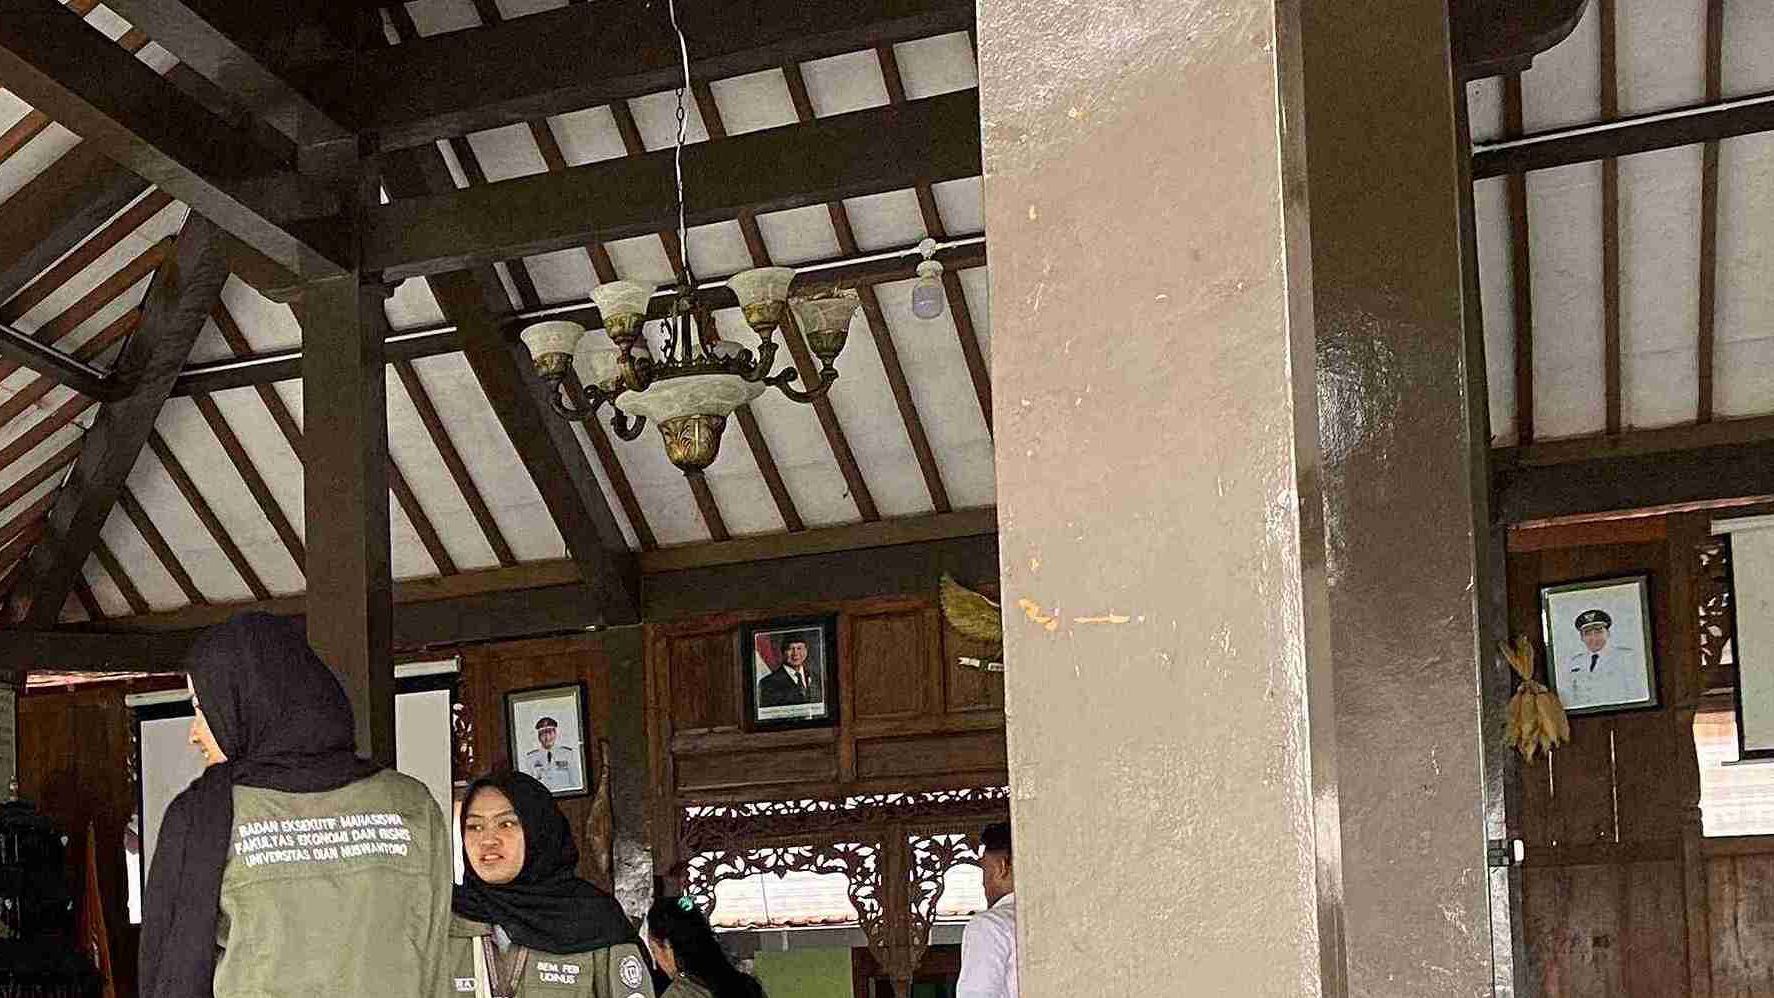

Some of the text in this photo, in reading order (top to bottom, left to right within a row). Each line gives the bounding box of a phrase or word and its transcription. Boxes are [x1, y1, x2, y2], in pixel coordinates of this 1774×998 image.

[239, 813, 404, 838] BADAN EKSEKUTIF MAHASISWA
[235, 834, 295, 856] FAKULTAS
[298, 830, 349, 847] EKONOMI
[352, 828, 377, 841] DAN
[243, 848, 312, 868] UNIVERSITAS
[313, 846, 339, 861] DIAN
